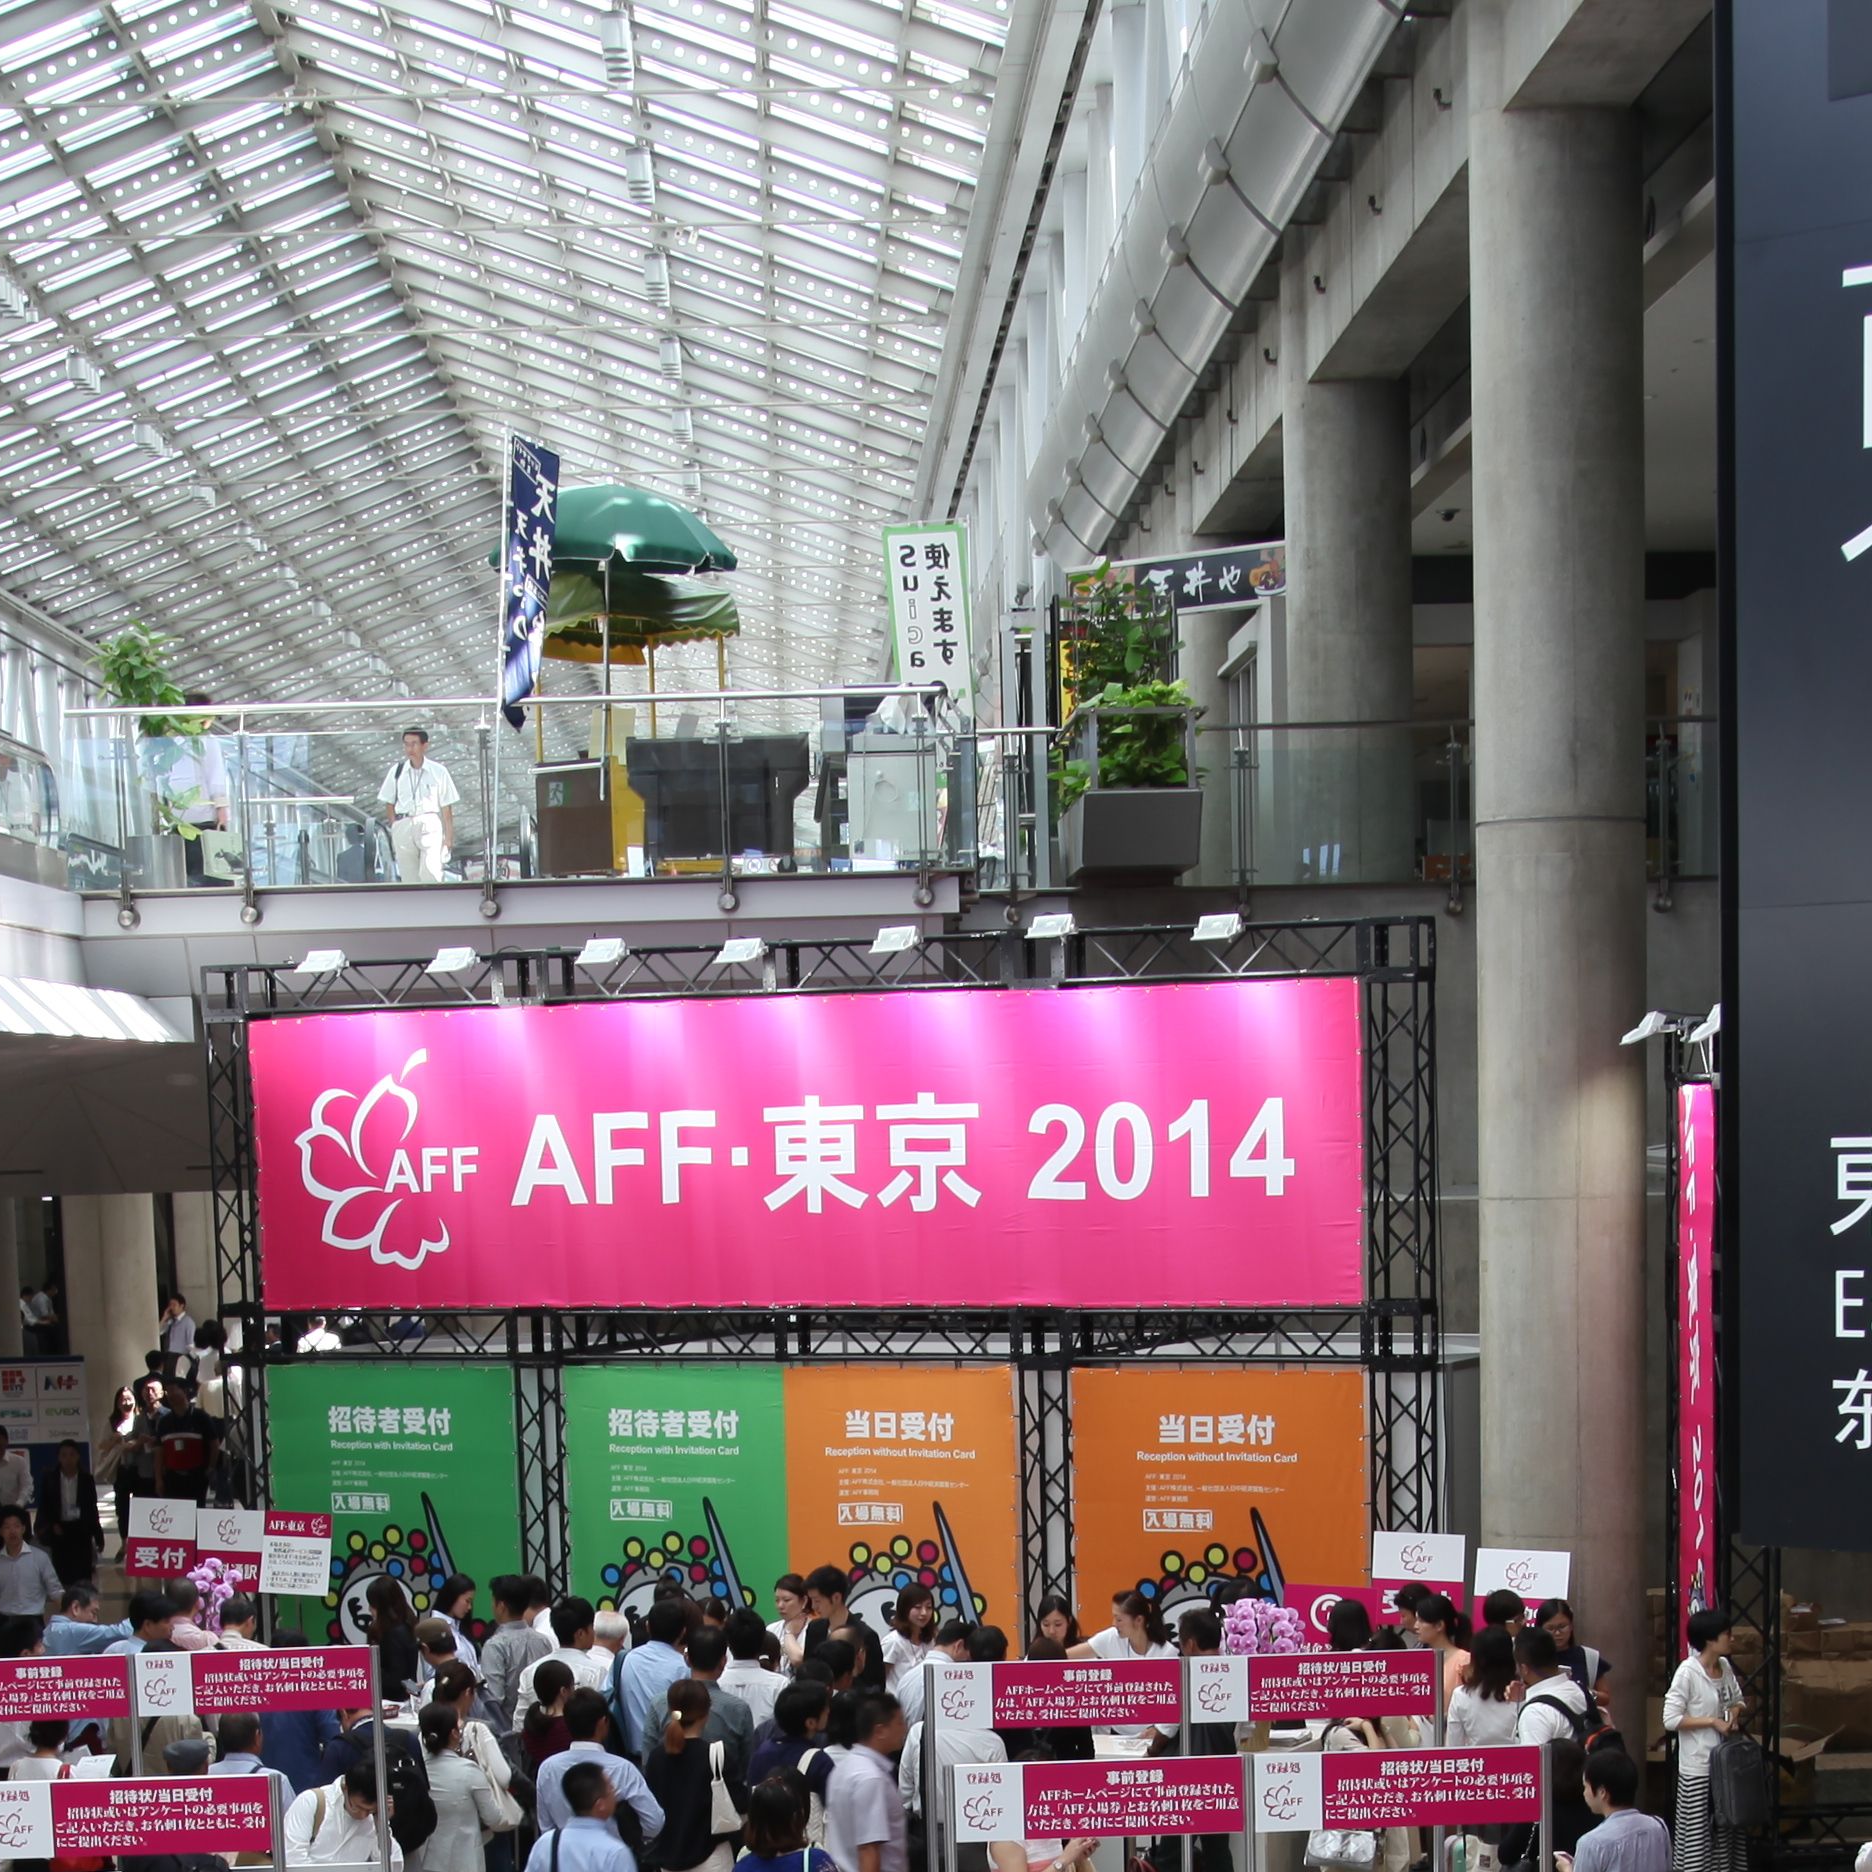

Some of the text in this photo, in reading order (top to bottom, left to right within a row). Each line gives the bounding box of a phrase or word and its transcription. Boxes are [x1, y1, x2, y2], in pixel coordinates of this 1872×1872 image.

[1027, 1096, 1295, 1202] 2014
[383, 1146, 479, 1194] AFF
[328, 1405, 452, 1437] 招待者受付
[609, 1408, 739, 1440] 招待者受付
[845, 1409, 954, 1442] 当日受付
[1159, 1414, 1275, 1445] 当日受付
[330, 1439, 453, 1453] Reception with Invitation Card
[609, 1443, 739, 1456] Reception with Invitation Card
[825, 1446, 976, 1460] Reception without Invitation Card
[1136, 1451, 1298, 1464] Reception without Invitation Card
[334, 1495, 390, 1512] 入場無料
[612, 1500, 671, 1519] 入場無料
[840, 1505, 901, 1524] 入場無料
[1146, 1511, 1212, 1530] 入場無料
[134, 1547, 186, 1570] 受付
[1416, 1555, 1433, 1564] AFF
[1521, 1572, 1539, 1581] AFF
[15, 1665, 63, 1679] 事前登録
[238, 1655, 324, 1671] 招待状/当日受付
[1297, 1659, 1386, 1675] 招待状/当日受付
[1062, 1668, 1112, 1682] 事前登録
[1380, 1757, 1484, 1776] 招待状/当日受付
[1105, 1769, 1164, 1785] 事前登録
[108, 1786, 213, 1805] 招待状/当日受付
